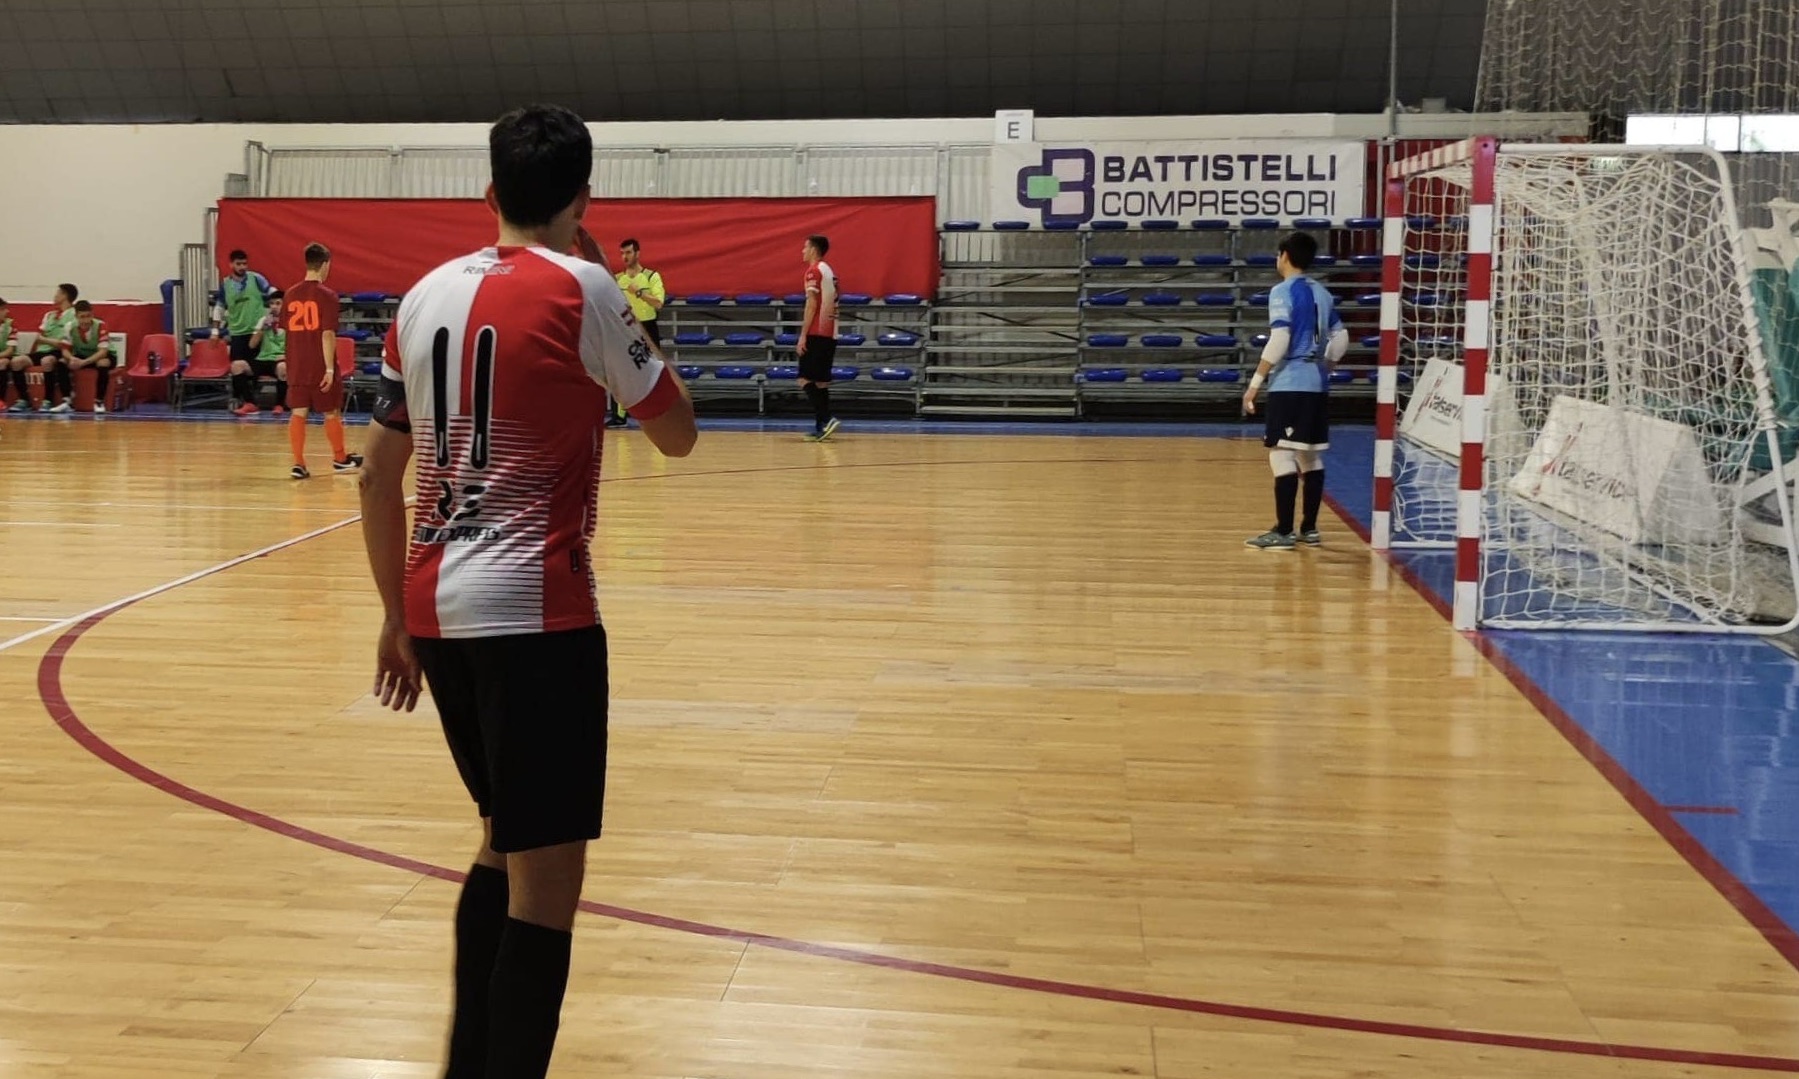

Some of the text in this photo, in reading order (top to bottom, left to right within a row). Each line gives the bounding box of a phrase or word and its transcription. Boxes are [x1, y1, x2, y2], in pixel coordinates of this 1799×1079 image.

[1007, 121, 1020, 139] E
[1103, 154, 1336, 182] BATTISTELLI
[1101, 190, 1335, 217] COMPRESSORI
[288, 300, 319, 331] 20
[431, 324, 497, 470] 11
